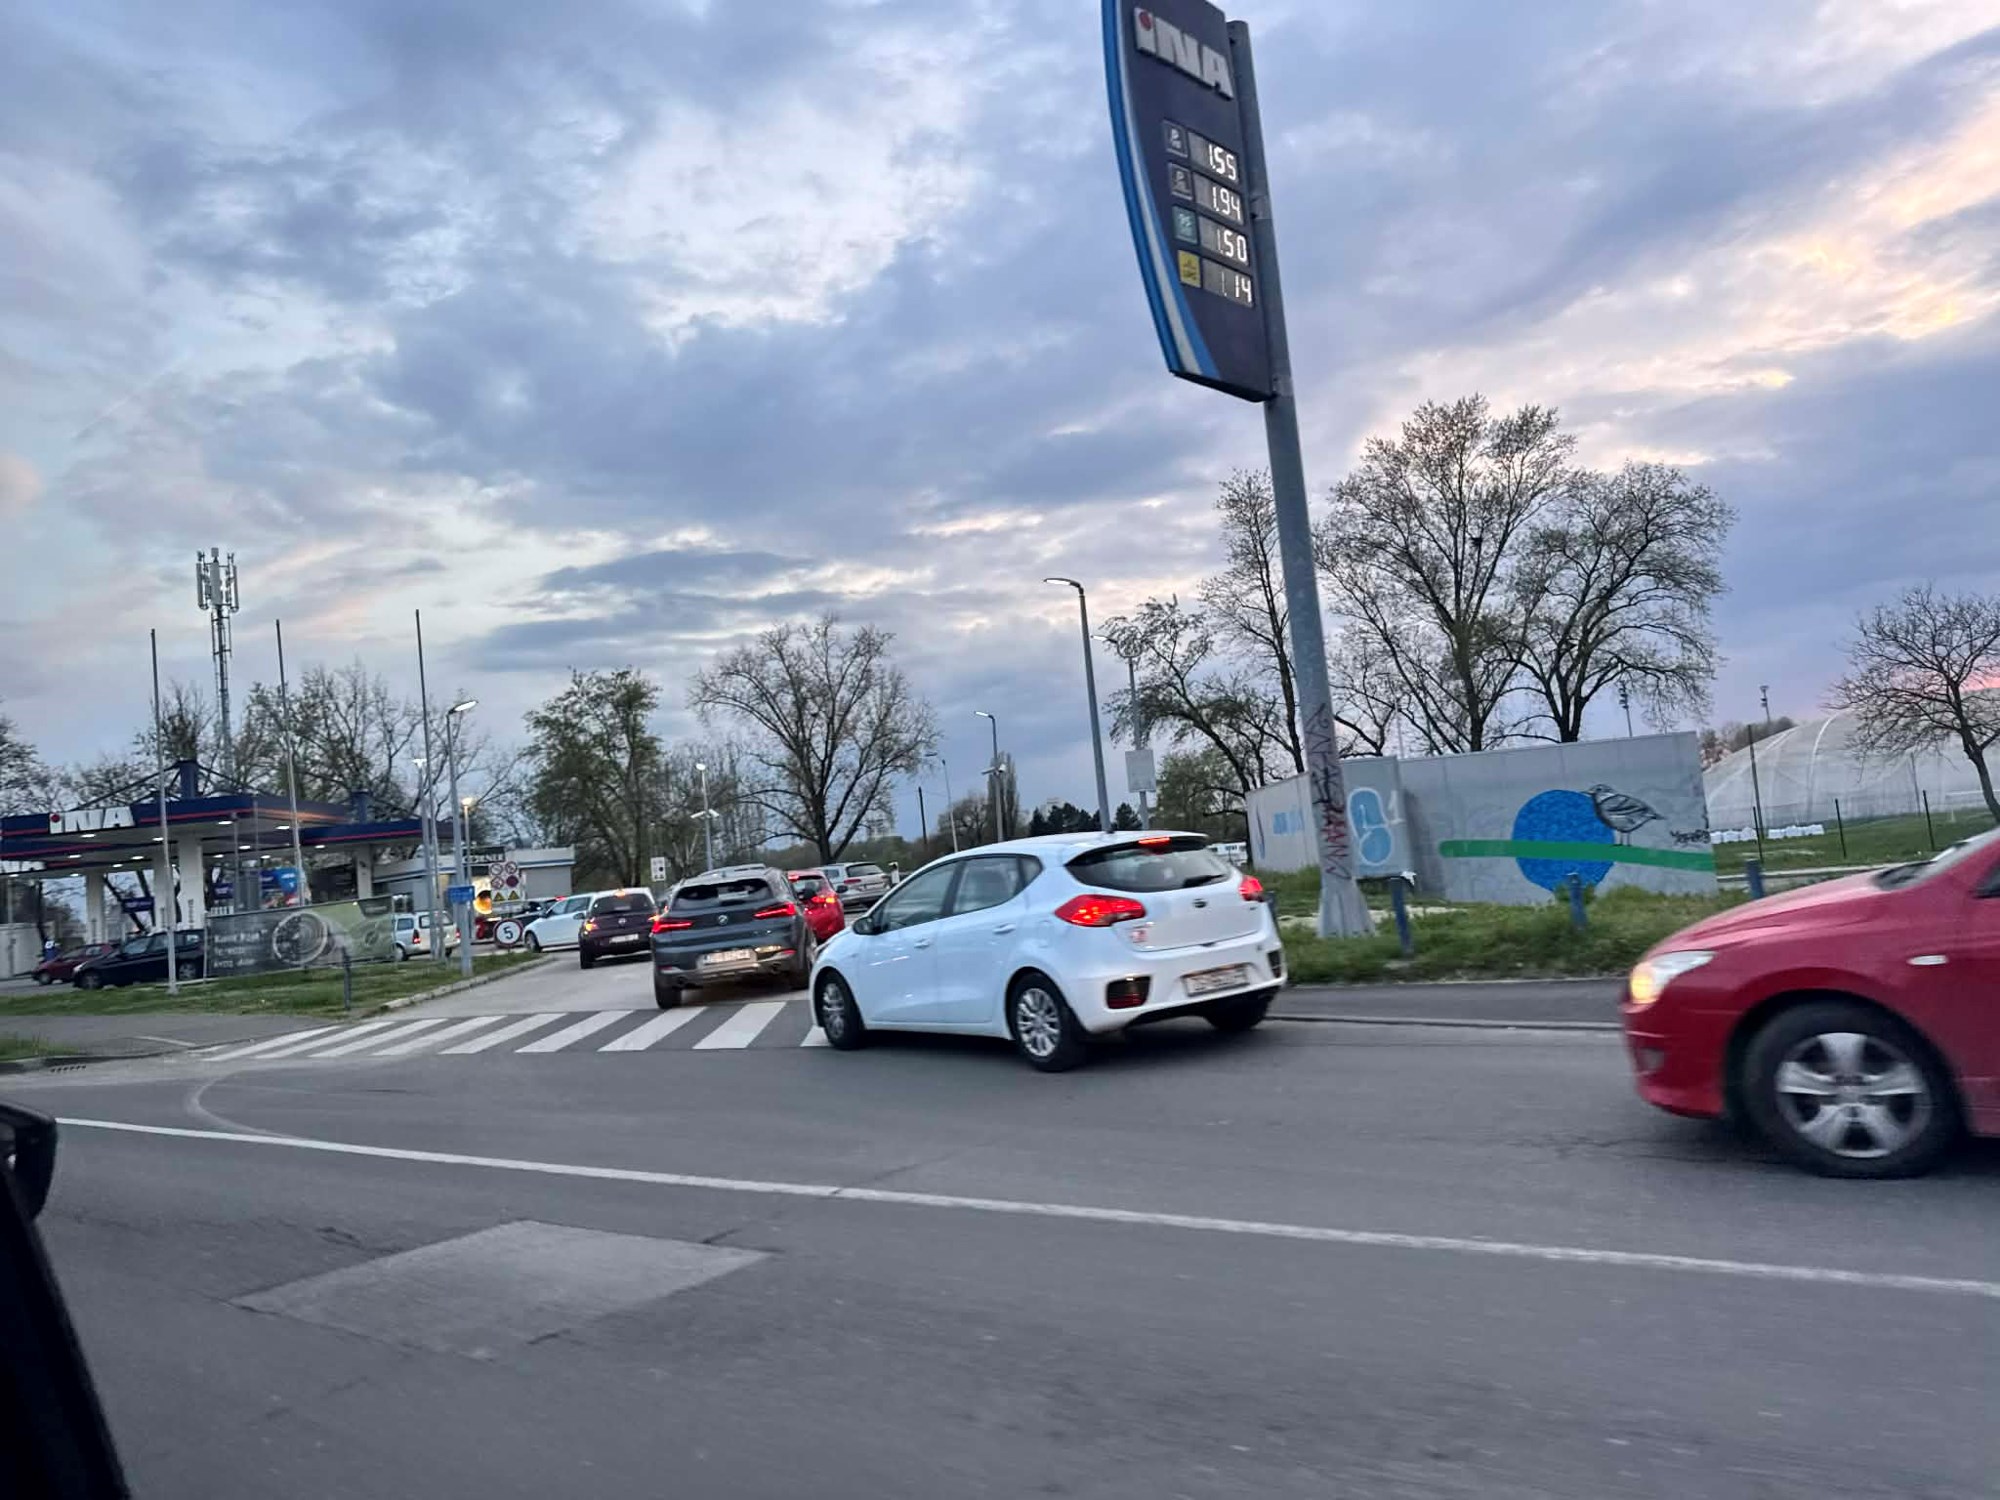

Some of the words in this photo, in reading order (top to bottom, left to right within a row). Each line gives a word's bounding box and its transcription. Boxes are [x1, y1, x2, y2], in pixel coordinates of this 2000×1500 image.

[1208, 143, 1236, 180] 1.55
[1212, 186, 1241, 221] 1.94
[1216, 228, 1247, 263] 1.50
[503, 925, 513, 940] 5
